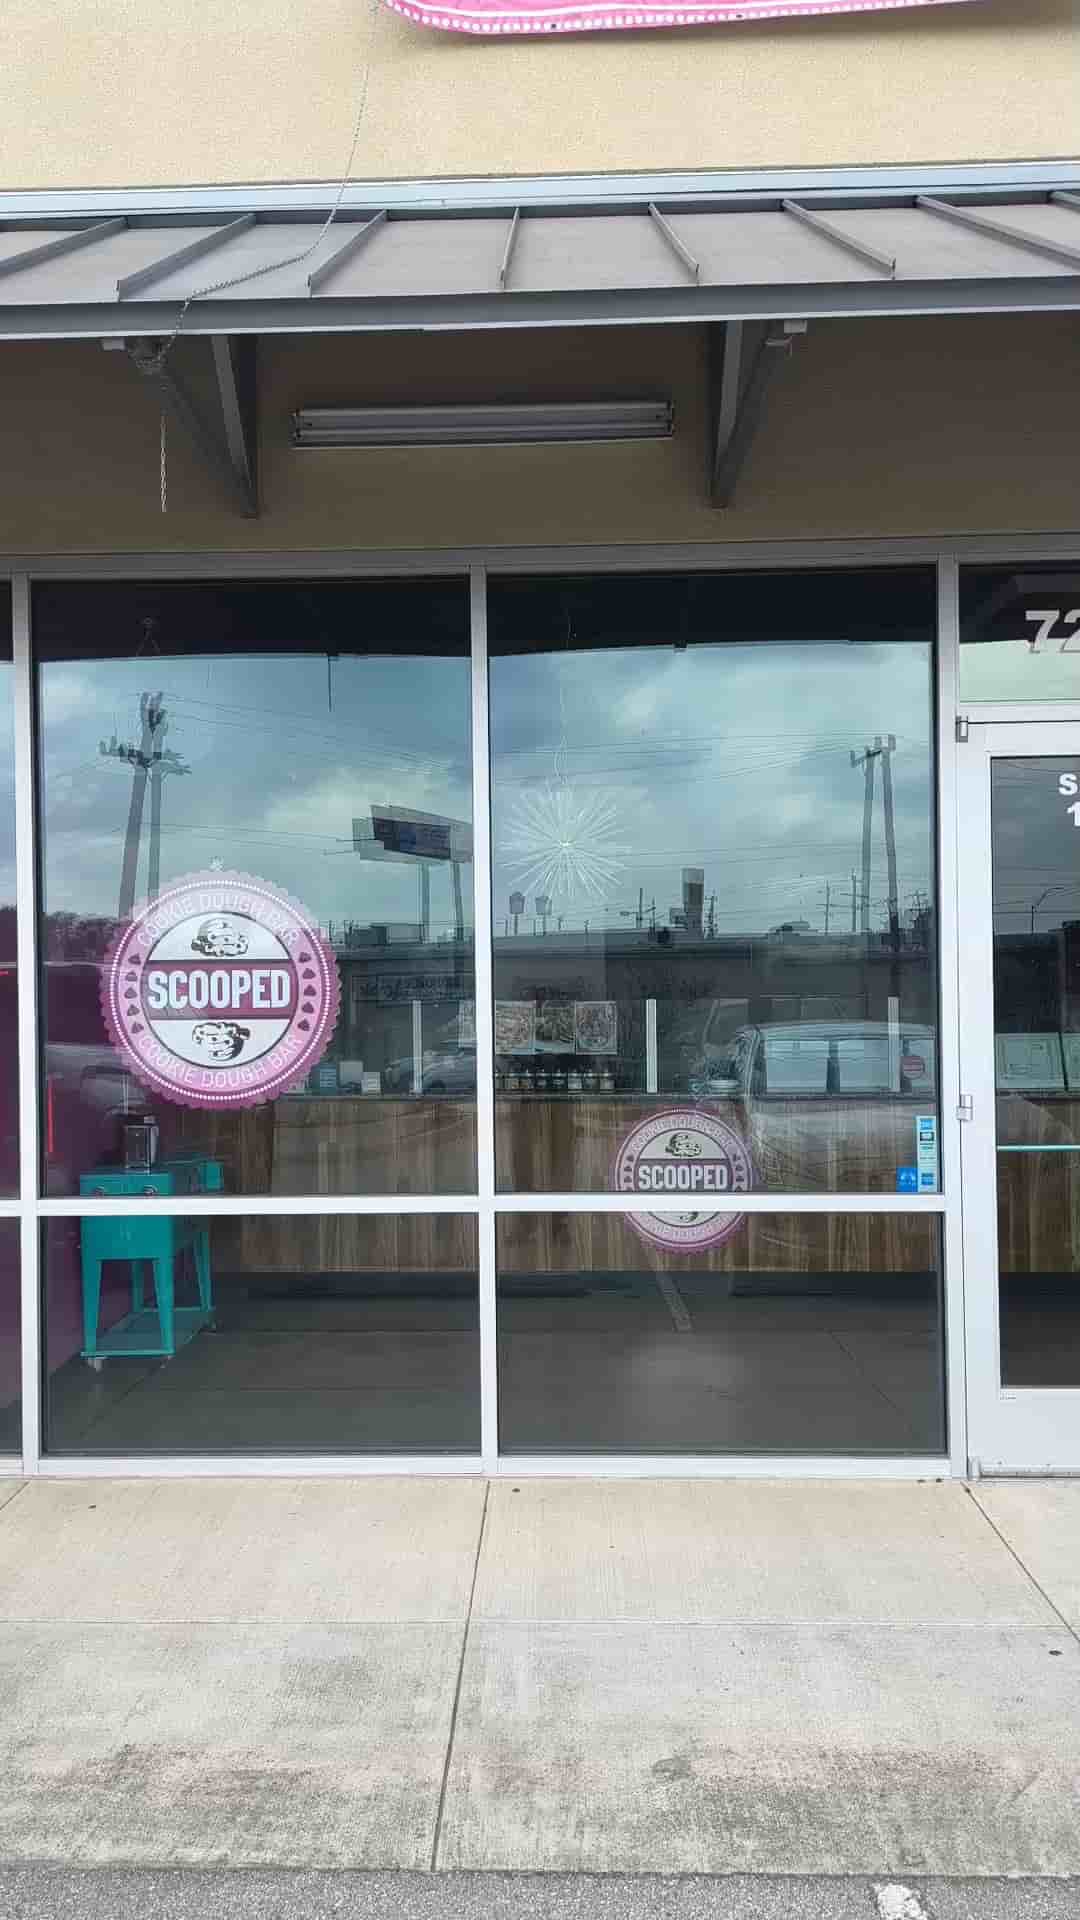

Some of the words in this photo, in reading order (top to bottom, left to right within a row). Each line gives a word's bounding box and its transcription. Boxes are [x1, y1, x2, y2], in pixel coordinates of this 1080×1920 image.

[137, 897, 194, 943] COOKIE
[199, 893, 265, 917] DOUGH
[268, 909, 299, 945] BAR
[147, 970, 290, 1009] SCOOPED
[139, 1037, 198, 1084] COOKIE
[200, 1064, 267, 1088] DOUGH
[270, 1037, 303, 1070] BAR
[638, 1164, 728, 1190] SCOOPED
